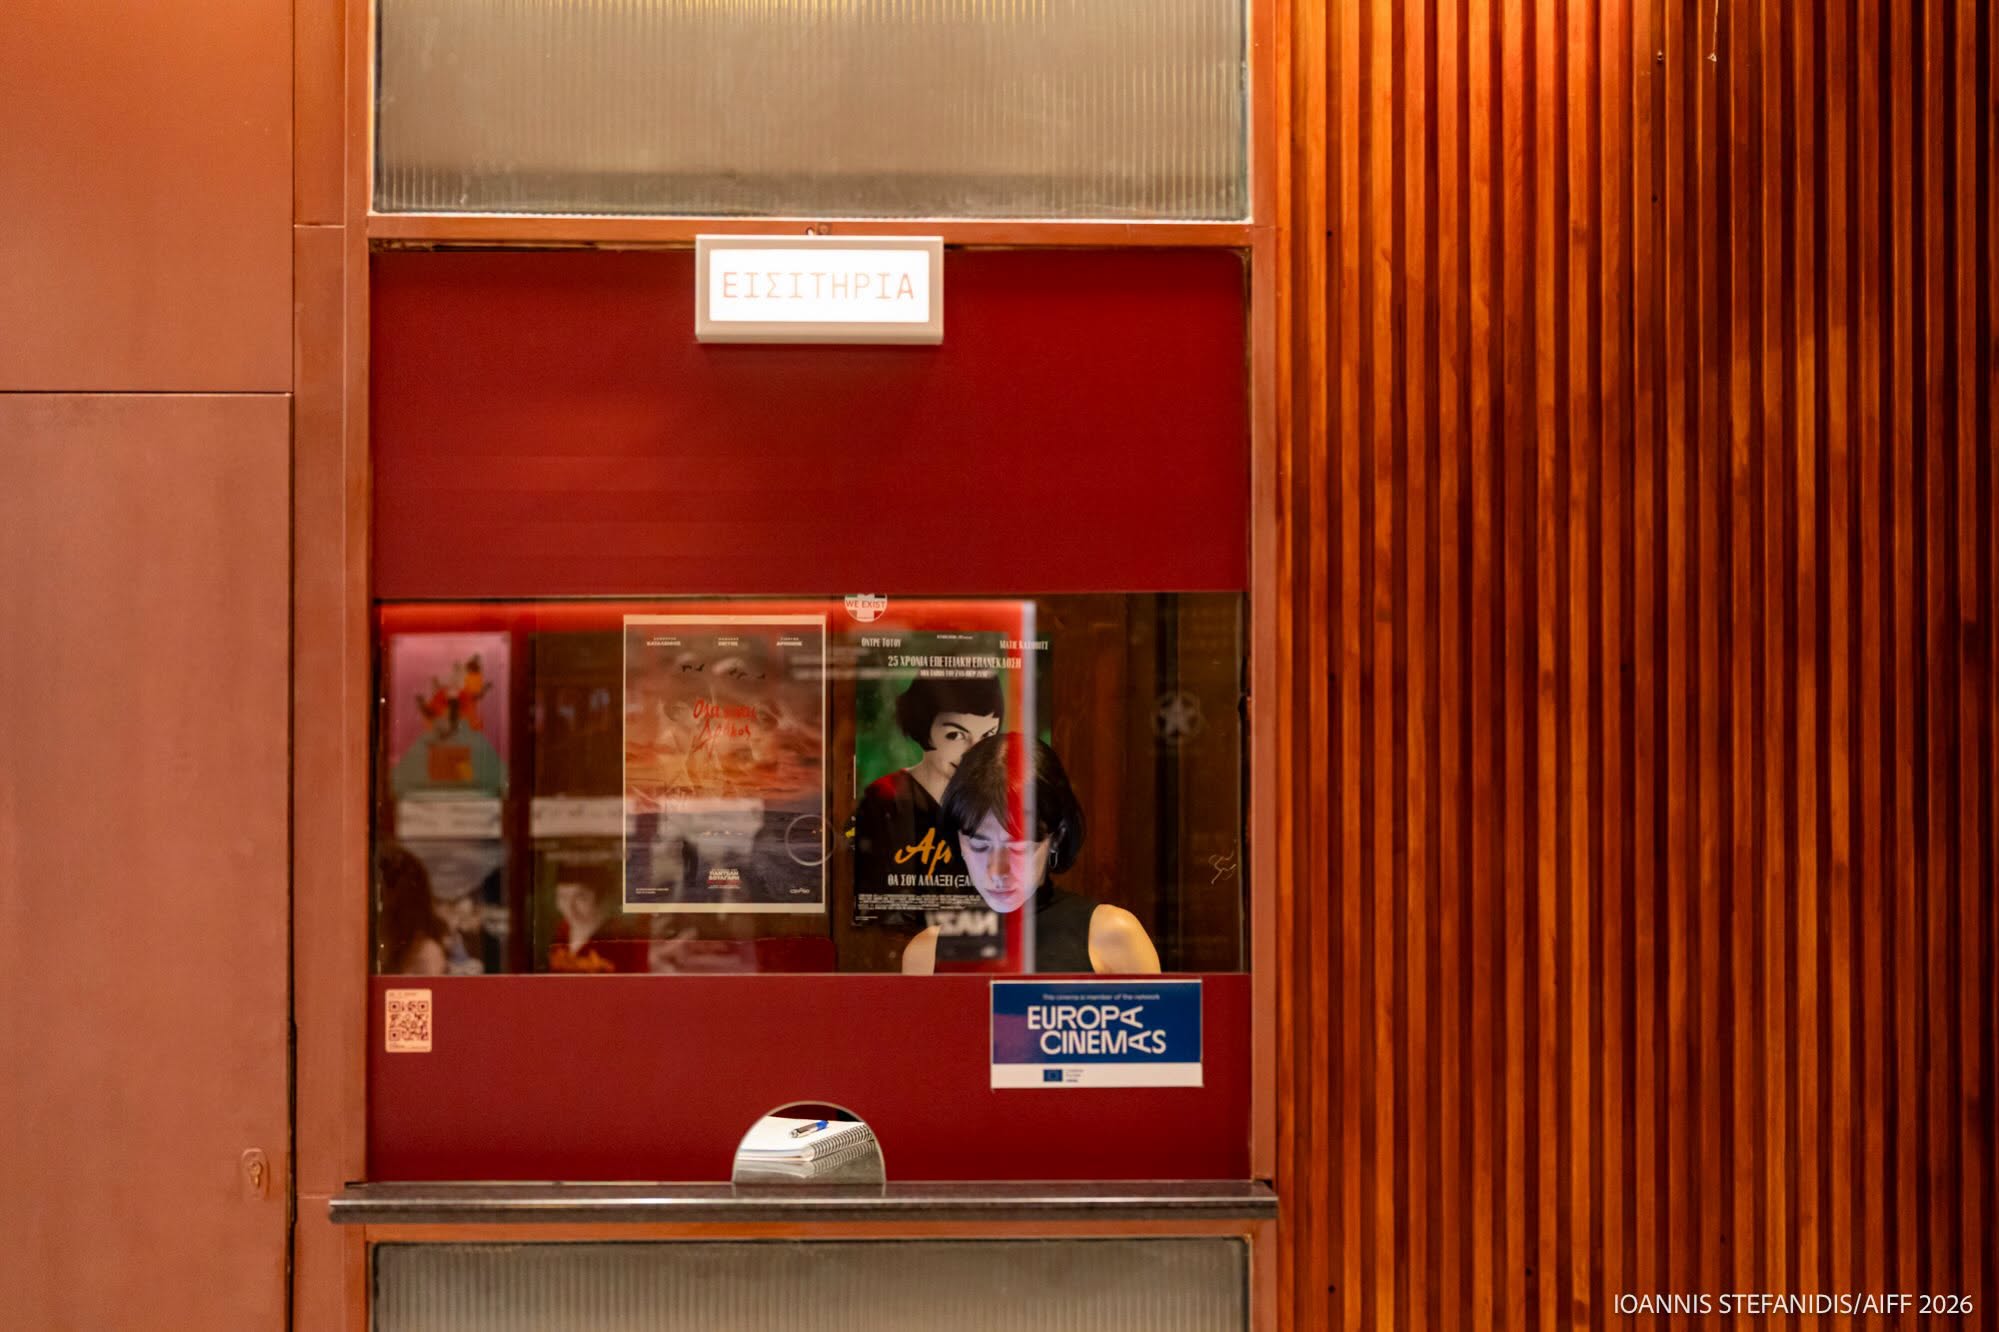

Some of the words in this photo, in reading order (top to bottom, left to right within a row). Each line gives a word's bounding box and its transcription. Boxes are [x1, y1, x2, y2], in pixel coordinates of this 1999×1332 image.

[721, 271, 916, 300] ΕΙΣΙΤΗΡΙΑ
[845, 600, 860, 608] WE
[861, 600, 886, 609] EXIST
[887, 654, 899, 667] 25
[900, 655, 928, 668] ΧΡΟΝΙΑ
[929, 655, 972, 668] ΕΠΕΤΕΙΑΚΗ
[887, 874, 899, 887] ΘΑ
[900, 874, 917, 887] ΣΟΥ
[1027, 1005, 1144, 1030] EUROPA
[1039, 1029, 1167, 1055] CINEMAS
